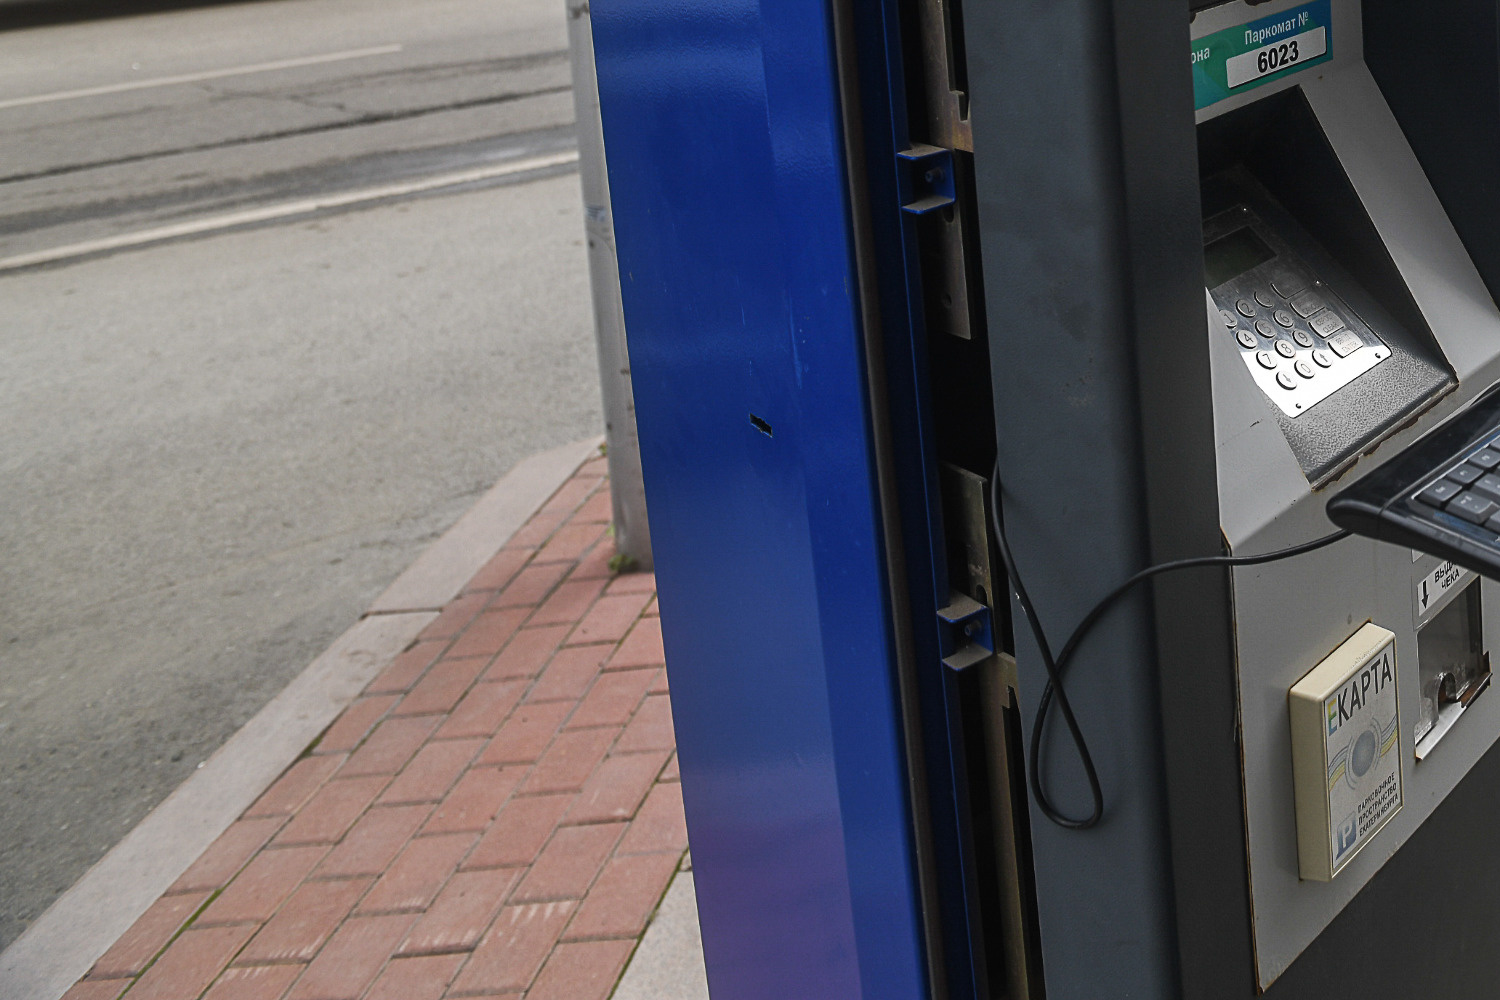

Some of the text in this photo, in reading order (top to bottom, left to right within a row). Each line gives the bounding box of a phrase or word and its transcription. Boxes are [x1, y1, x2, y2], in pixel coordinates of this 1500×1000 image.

[1244, 18, 1296, 45] Паркомат
[1257, 40, 1299, 73] 6023
[1434, 560, 1453, 584] ВЫД
[1441, 568, 1460, 589] ЧЕКА
[1357, 771, 1395, 813] ПАРКОВОЧНОЕ
[1358, 782, 1397, 825] ПРОСТРАНСТВО
